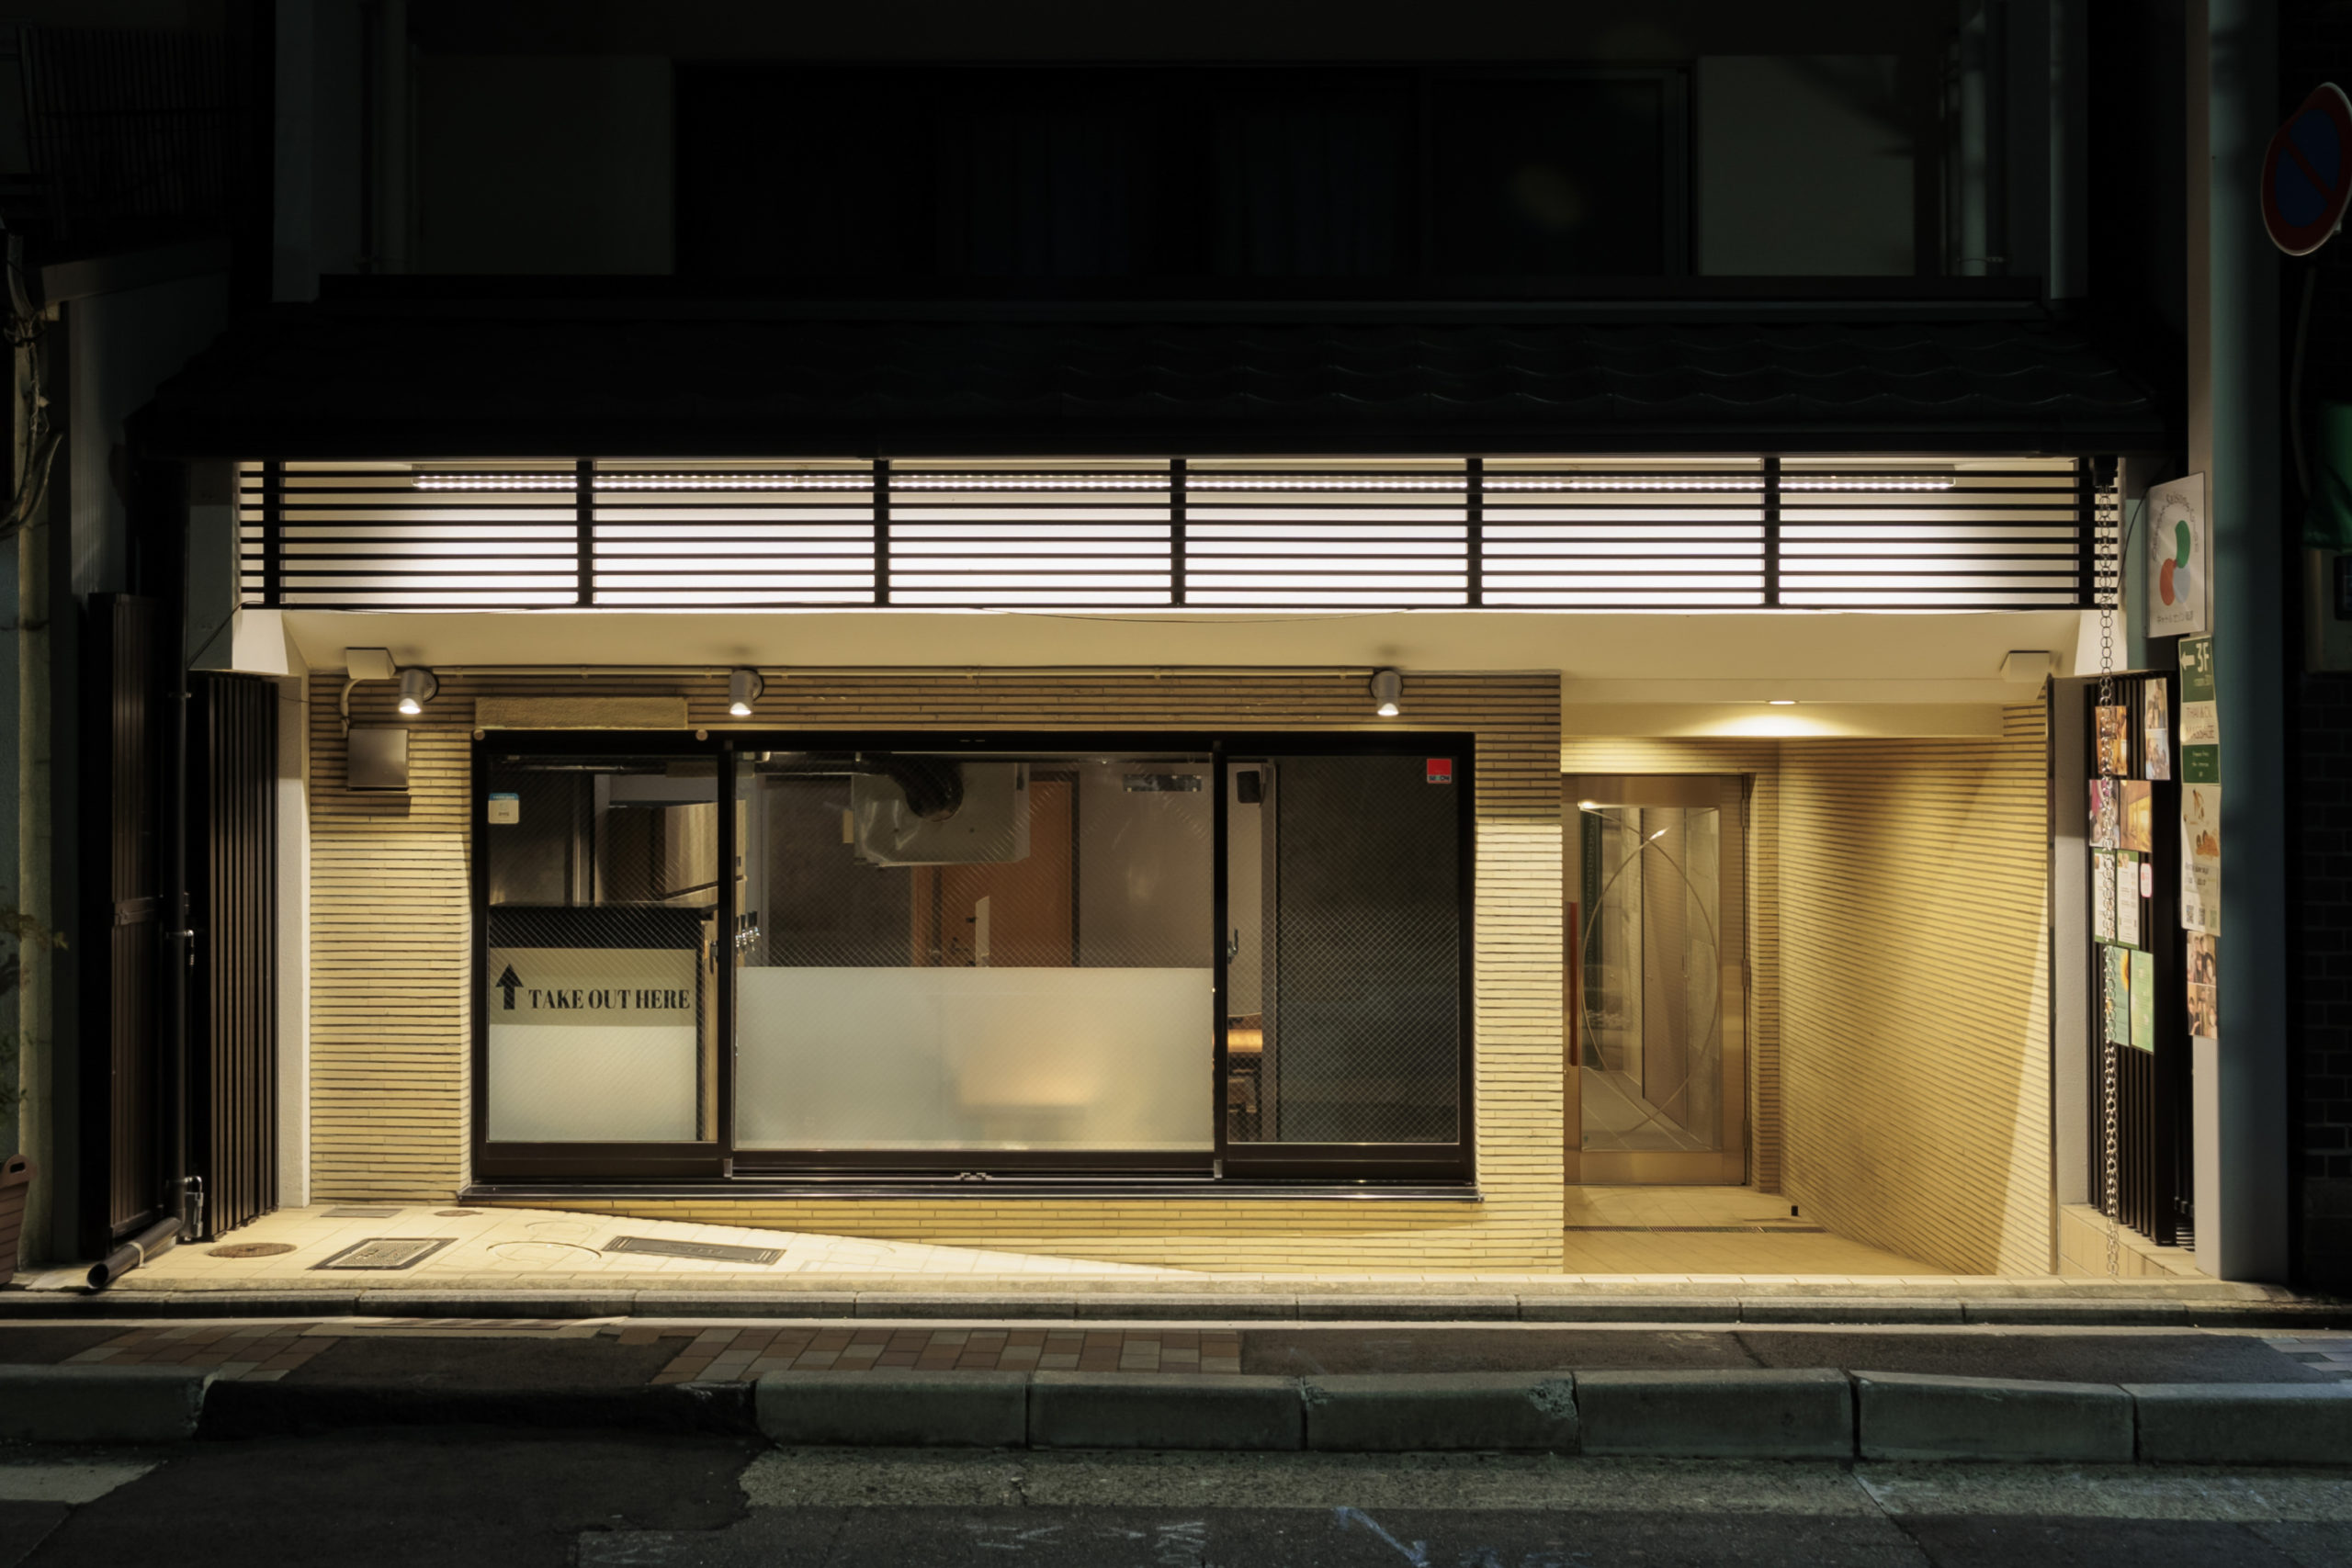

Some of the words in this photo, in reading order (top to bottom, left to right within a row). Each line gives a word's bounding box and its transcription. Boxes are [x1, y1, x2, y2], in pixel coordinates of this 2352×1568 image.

[2195, 642, 2210, 672] 3F
[528, 989, 584, 1010] TAKE
[588, 989, 631, 1010] OUT
[635, 989, 691, 1010] HERE
